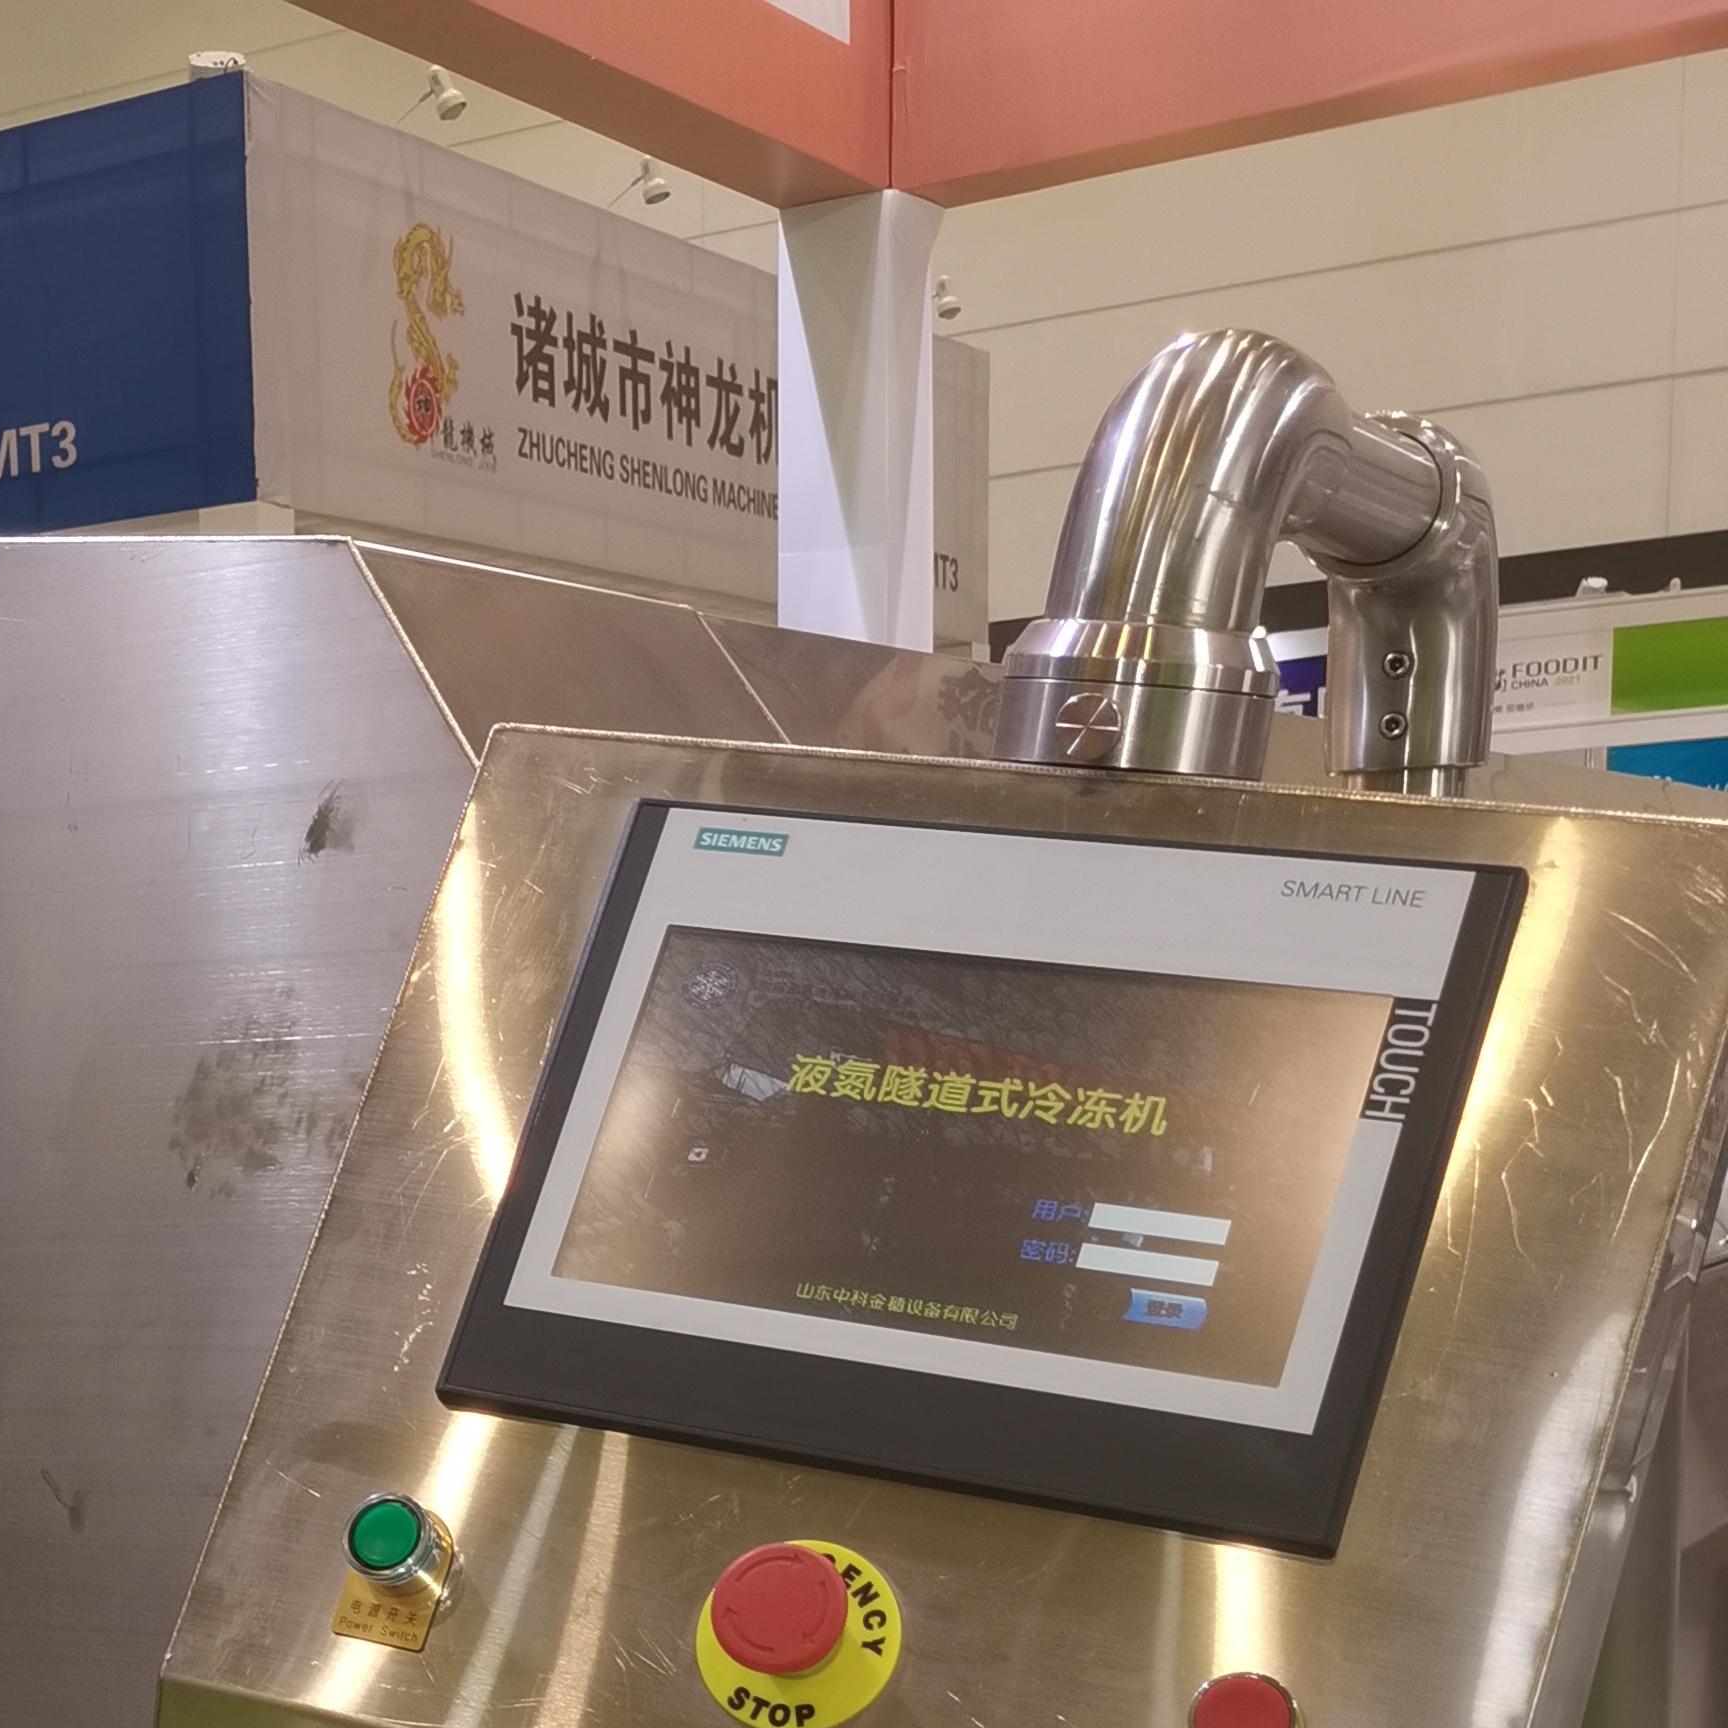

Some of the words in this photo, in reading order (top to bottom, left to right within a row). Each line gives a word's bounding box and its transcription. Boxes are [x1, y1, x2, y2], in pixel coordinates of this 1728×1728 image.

[517, 427, 615, 481] ZHUCHENG
[619, 454, 708, 504] SHENLONG
[933, 552, 959, 593] T3
[1510, 677, 1550, 691] CHINA
[699, 831, 784, 853] SIEMENS
[1280, 878, 1368, 903] SMART
[1370, 883, 1426, 909] LINE
[1364, 1003, 1439, 1120] TOUCH
[785, 1053, 1168, 1137] 液氮隧道式冷冻机
[337, 1615, 373, 1633] Power
[379, 1625, 419, 1643] Switch
[727, 1686, 816, 1728] STOP
